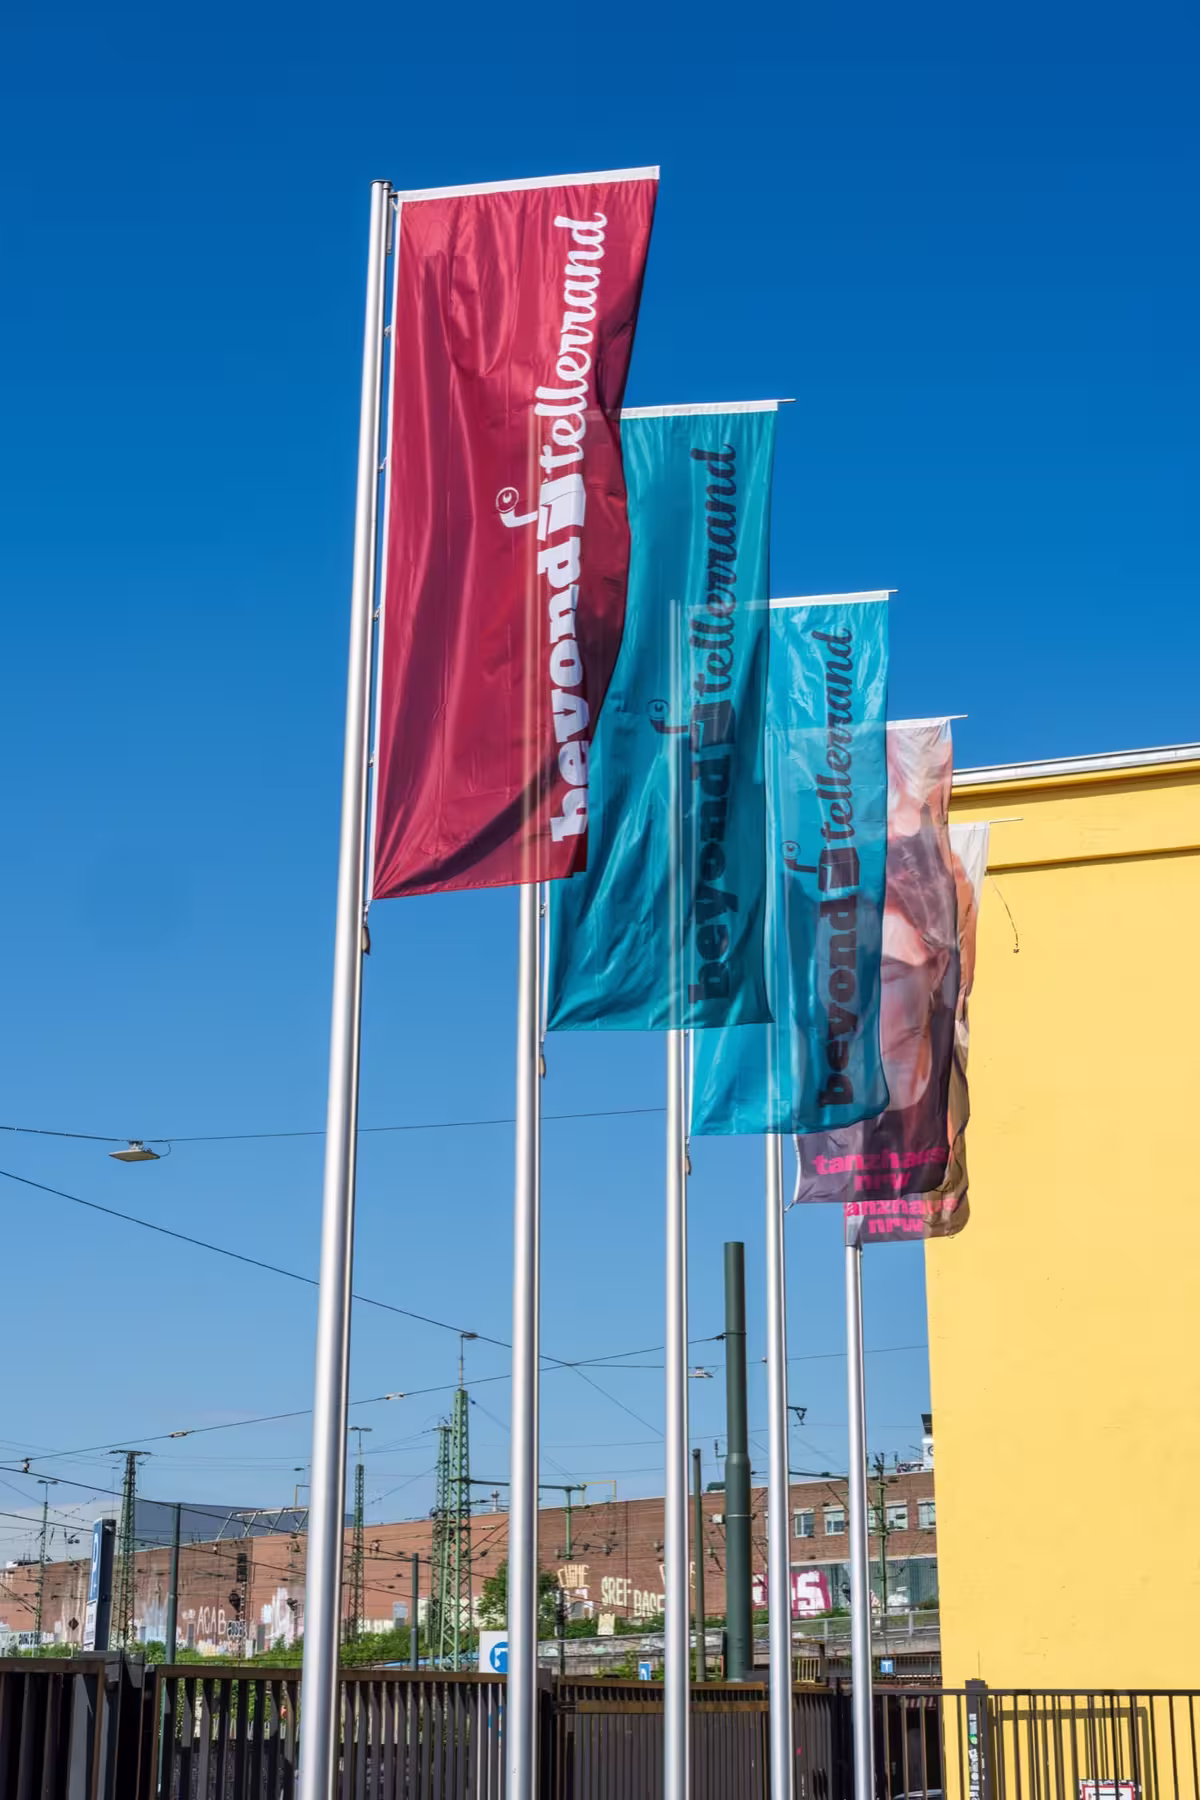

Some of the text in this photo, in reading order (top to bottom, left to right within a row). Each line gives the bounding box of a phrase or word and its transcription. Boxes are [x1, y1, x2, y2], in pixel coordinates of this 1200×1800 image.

[533, 211, 608, 842] beyond tellerrand
[687, 443, 739, 1005] beyond tellerrand
[811, 626, 859, 1109] beyond tellerrand
[812, 1146, 946, 1175] tanzhaus
[854, 1171, 912, 1192] nrw
[868, 1216, 925, 1234] nrw
[196, 1605, 227, 1635] ACAB
